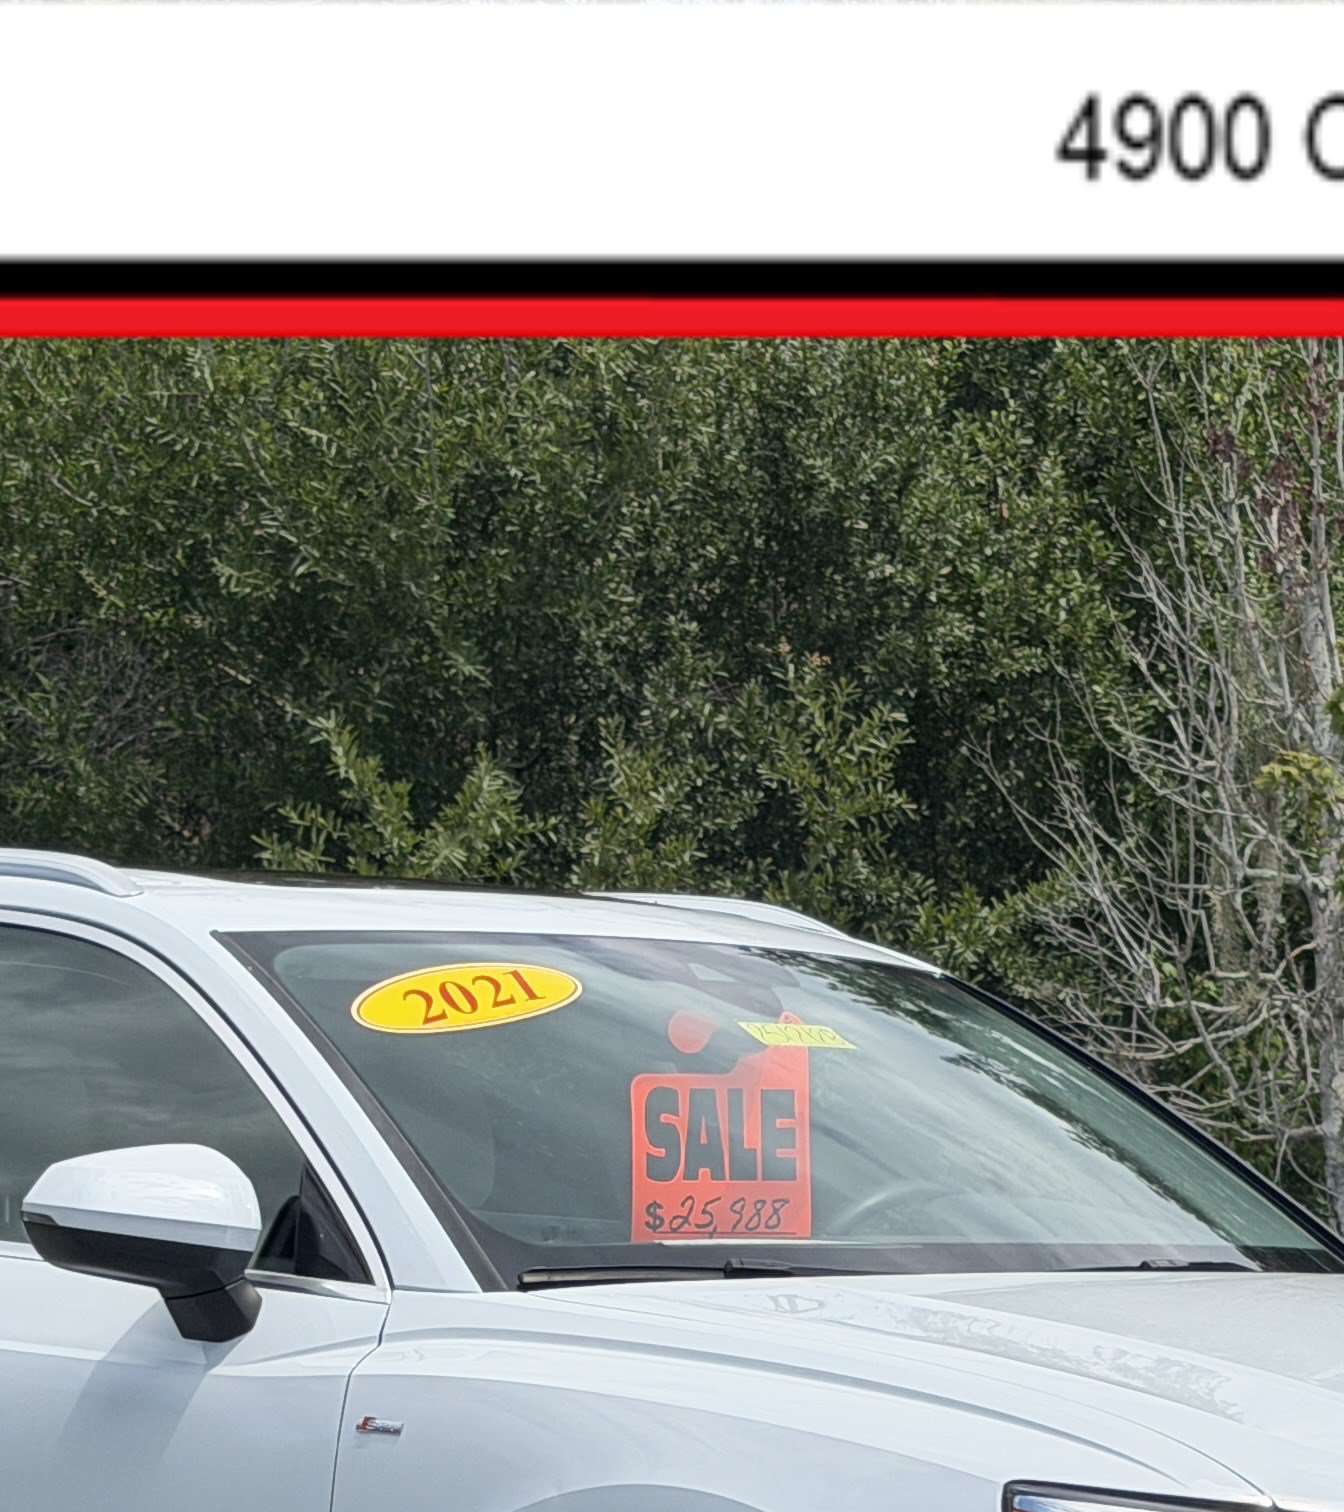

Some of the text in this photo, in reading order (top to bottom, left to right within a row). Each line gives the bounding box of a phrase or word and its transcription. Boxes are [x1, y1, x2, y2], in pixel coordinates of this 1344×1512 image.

[402, 969, 546, 1025] 2021
[645, 1085, 798, 1182] SALE
[644, 1195, 791, 1239] $25,988
